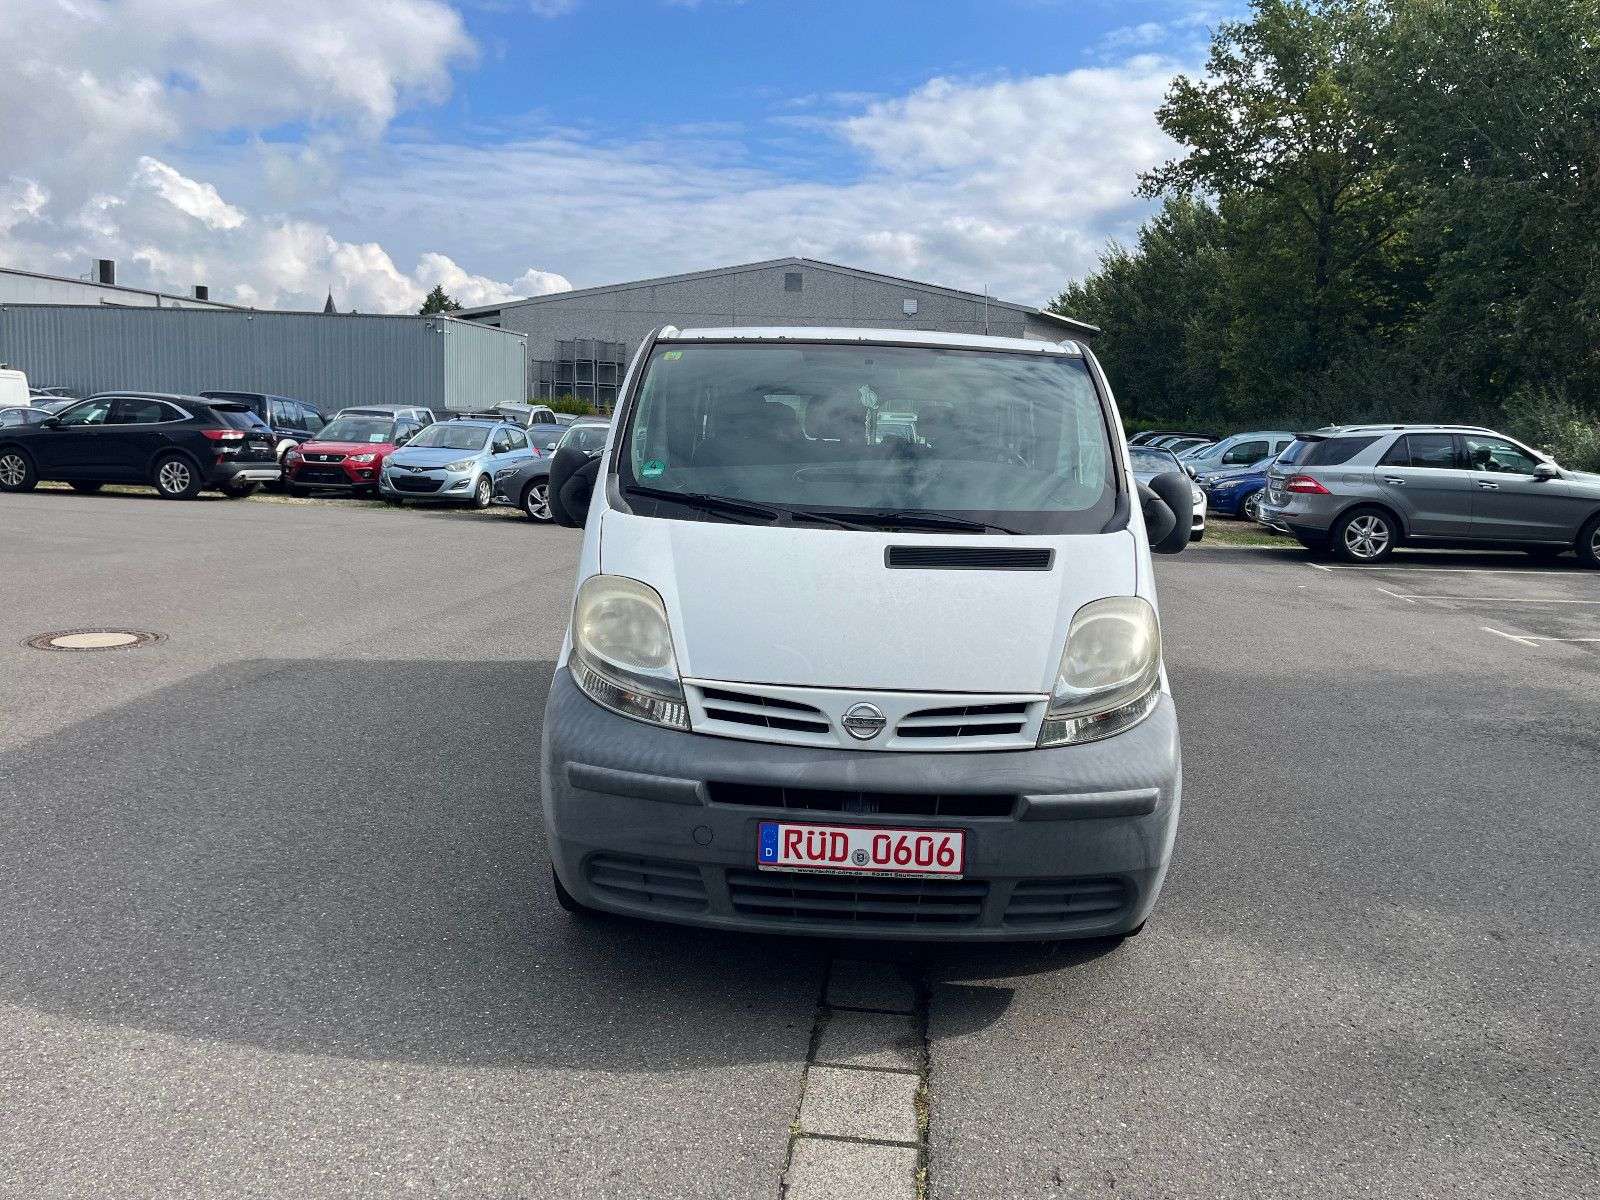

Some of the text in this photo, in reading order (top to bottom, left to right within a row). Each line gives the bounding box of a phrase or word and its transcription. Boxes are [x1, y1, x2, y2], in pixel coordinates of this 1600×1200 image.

[765, 847, 773, 857] D
[783, 829, 955, 867] RÜD 0606
